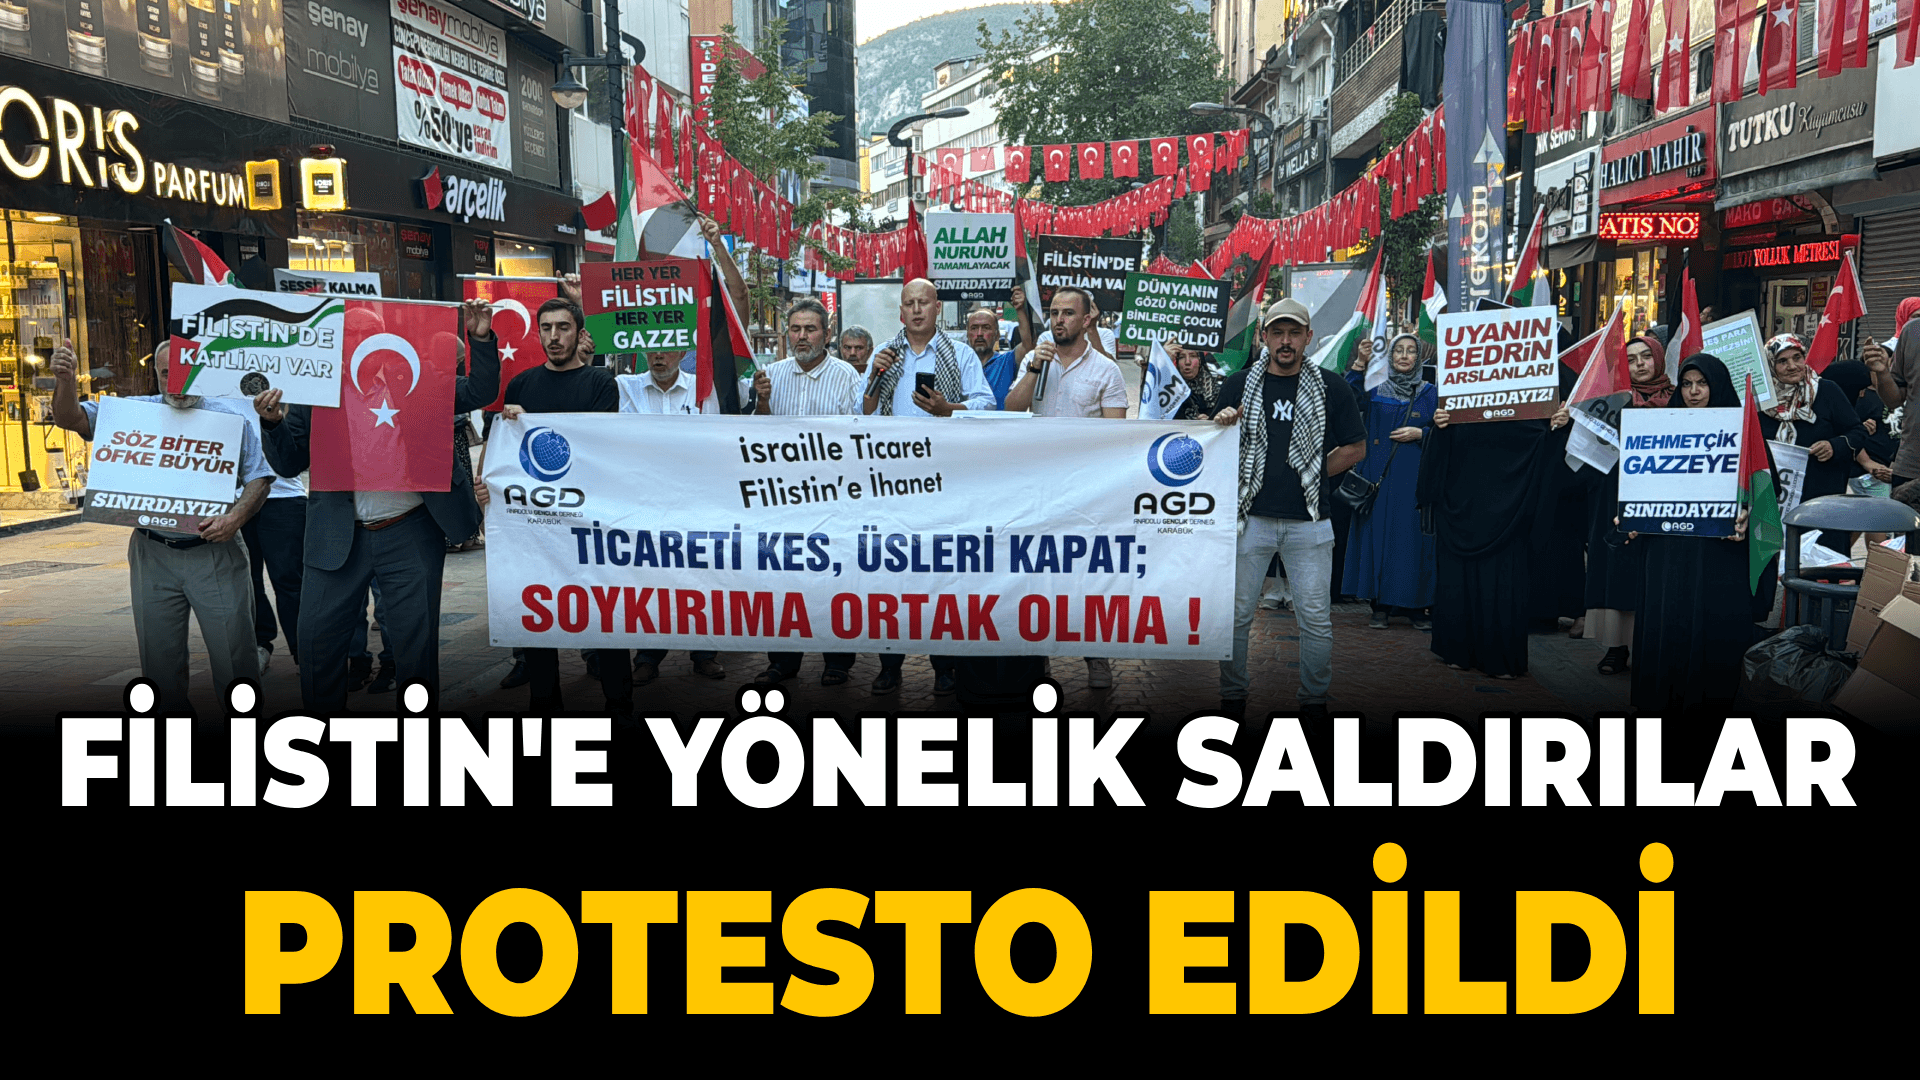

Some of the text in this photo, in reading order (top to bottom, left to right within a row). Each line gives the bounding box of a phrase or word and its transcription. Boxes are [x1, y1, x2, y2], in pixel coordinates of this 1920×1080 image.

[308, 0, 368, 47] şenay
[448, 15, 498, 54] mobilya
[307, 47, 378, 91] mobilya
[1728, 101, 1867, 152] TUTKU Kuyumcusu
[1600, 125, 1702, 189] HALICI MAHİR
[153, 161, 246, 208] PARFUM
[445, 174, 507, 223] arçelik
[933, 226, 1007, 244] ALLAH
[934, 246, 1008, 259] NURUNU
[1043, 250, 1135, 272] FİLİSTİN'DE
[1754, 245, 1791, 267] YOLLUK
[612, 266, 680, 281] HER YER
[933, 261, 1010, 270] TAMAMLAYACAK
[328, 281, 378, 296] KALMA
[934, 278, 1013, 290] SINIRDAYIZ!
[1042, 274, 1102, 290] KATLİAM
[1138, 279, 1218, 299] DÜNYANIN
[601, 283, 694, 308] FİLİSTİN
[1135, 296, 1218, 314] GÖZÜ ÖNÜNDE
[616, 310, 684, 326] HER YER
[1126, 308, 1223, 329] BİNLERCE ÇOCUK
[182, 312, 334, 348] FİLİSTİN'DE
[613, 329, 690, 350] GAZZE
[1126, 324, 1220, 348] ÖLDÜRÜLDÜ
[1444, 316, 1552, 346] UYANIN
[1722, 328, 1747, 340] PARA
[180, 348, 333, 378] KATLİAM VAR
[1443, 362, 1554, 385] ARSLANLARI
[1444, 388, 1554, 410] SINIRDAYIZ!
[1493, 408, 1515, 417] AGD
[110, 430, 224, 456] SÖZ BİTER
[739, 432, 932, 464] israille Ticaret
[1624, 429, 1738, 452] MEHMETÇİK
[95, 444, 235, 475] ÖFKE BÜYÜR
[1624, 454, 1740, 474] GAZZEYE
[504, 484, 586, 508] AGD
[739, 467, 942, 508] Filistin'e İhanet
[1134, 491, 1216, 516] AGD
[1622, 502, 1737, 518] SINIRDAYIZ!
[150, 516, 178, 526] AGD
[527, 518, 562, 526] KARABÜK
[1157, 526, 1194, 534] KARABÜK
[1672, 522, 1694, 530] AGD
[570, 520, 1148, 579] TİCARETİ KES, ÜSLERİ KAPAT;
[520, 584, 814, 639] SOYKIRIMA
[830, 592, 1001, 642] ORTAK
[1018, 594, 1168, 645] OLMA
